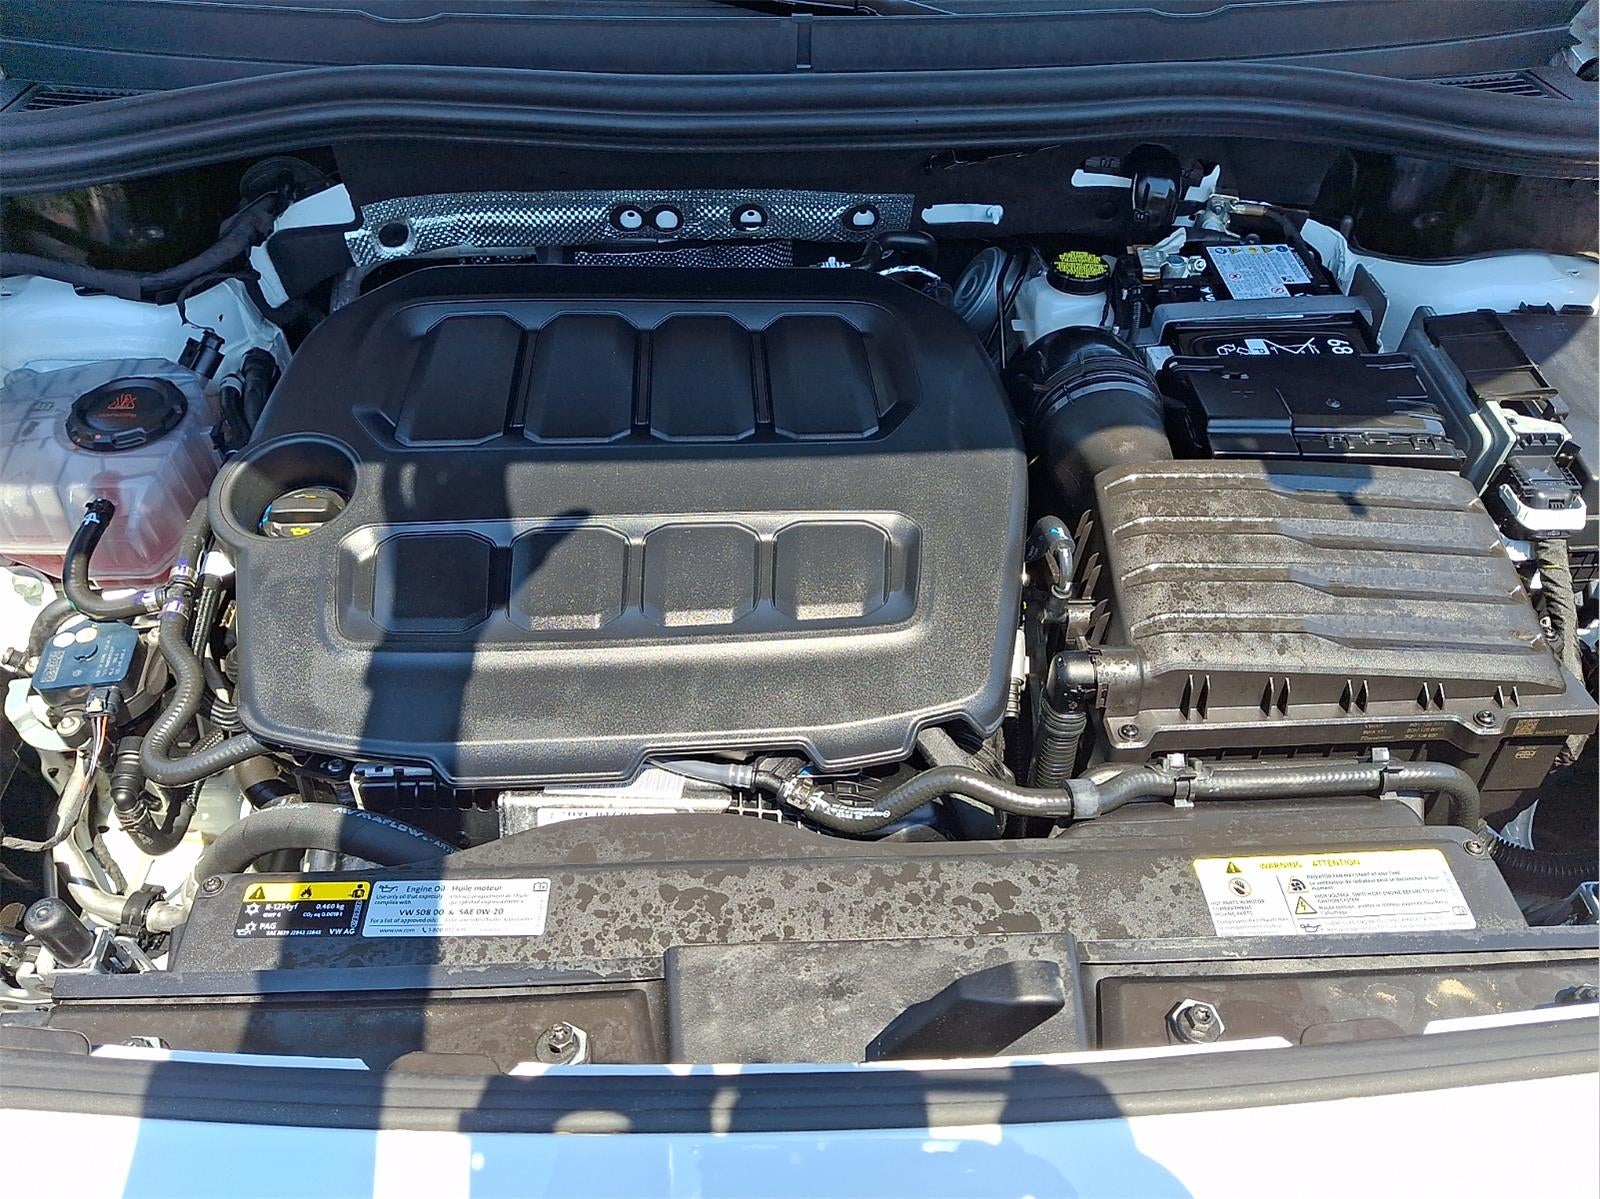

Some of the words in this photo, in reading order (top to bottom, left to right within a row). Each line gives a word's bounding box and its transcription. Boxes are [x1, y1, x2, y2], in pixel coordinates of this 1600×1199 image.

[1312, 859, 1361, 868] ATTENTION
[406, 885, 433, 893] Engine
[265, 903, 299, 912] R-1234yf
[337, 903, 345, 911] kg
[399, 908, 414, 916] VW
[415, 908, 431, 916] 508
[476, 907, 504, 915] 0W-20
[259, 922, 277, 930] PAG
